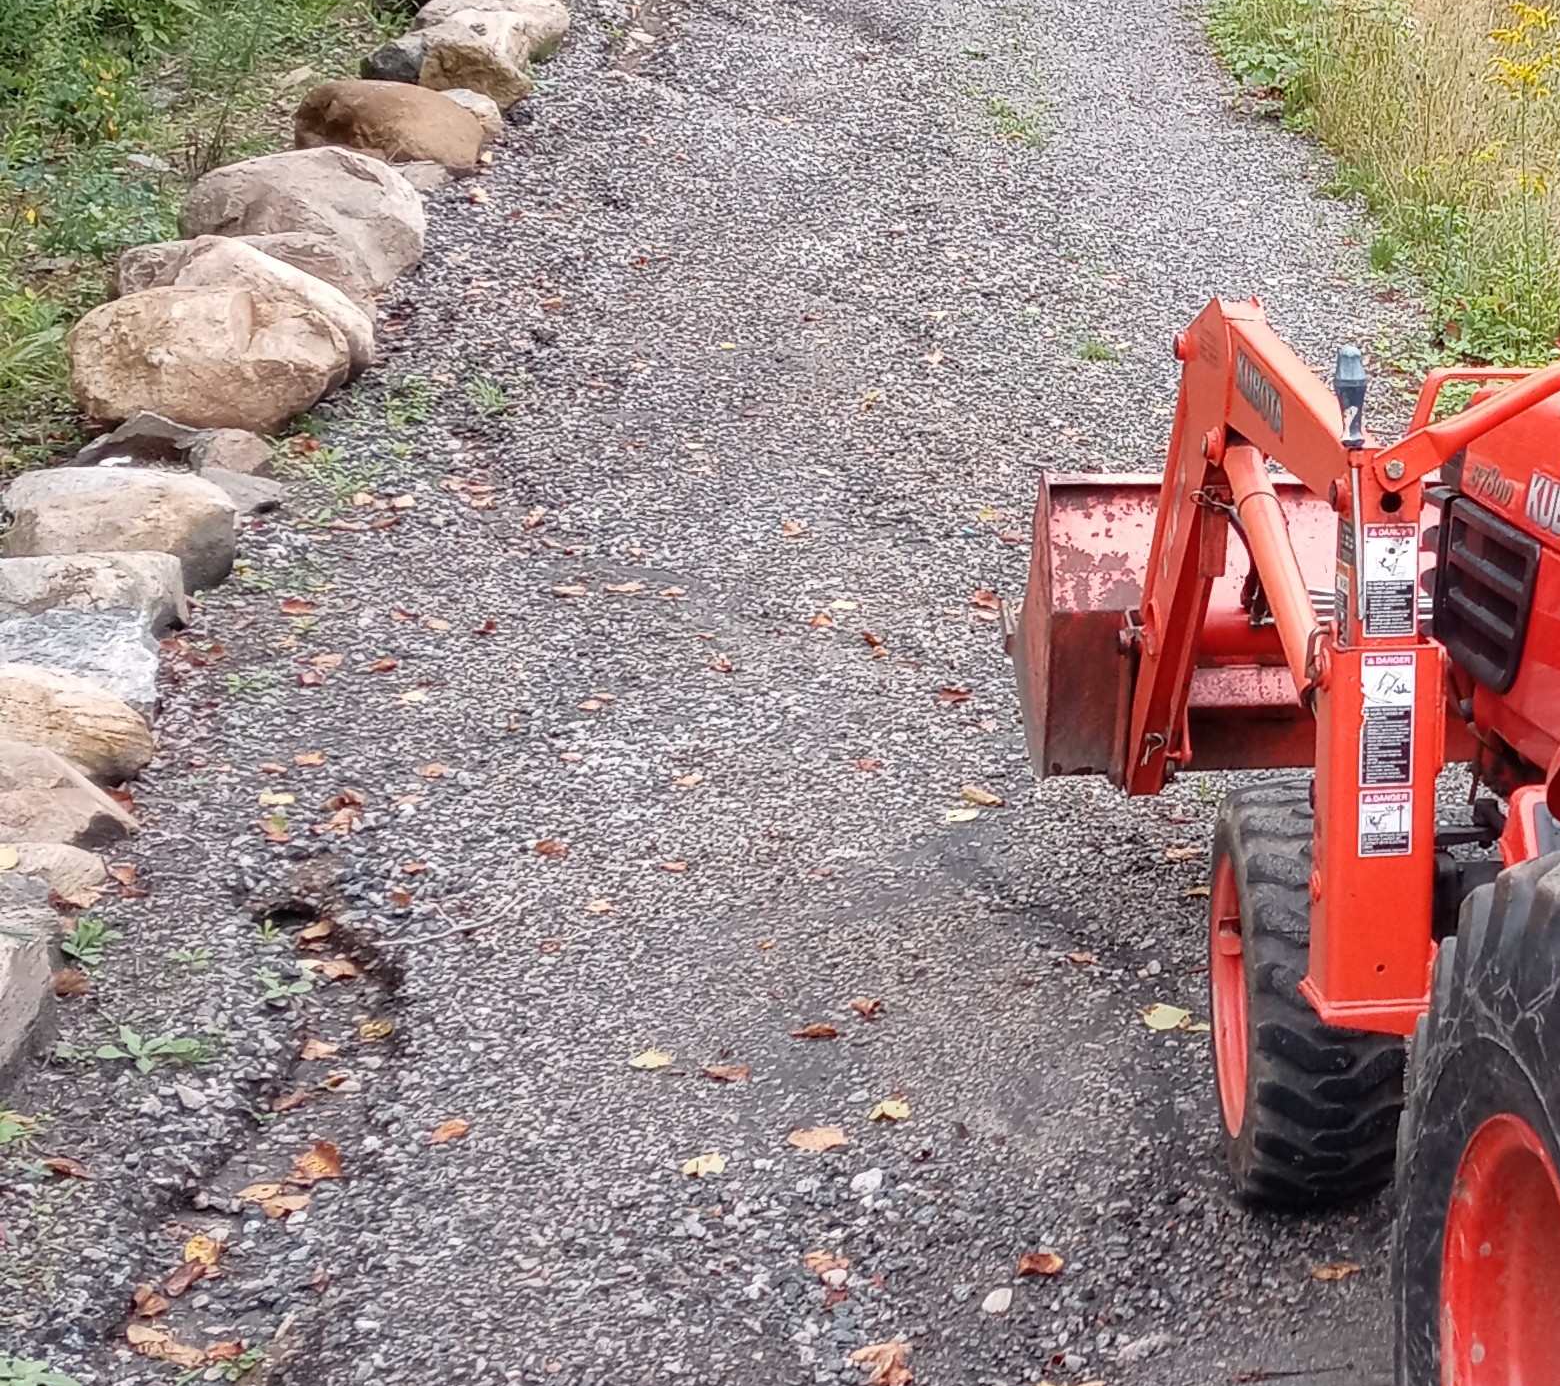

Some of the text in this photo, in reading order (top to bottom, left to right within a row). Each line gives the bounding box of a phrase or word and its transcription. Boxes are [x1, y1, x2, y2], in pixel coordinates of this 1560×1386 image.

[1236, 348, 1284, 439] KUBOTA
[1376, 656, 1411, 665] DANGER
[1372, 793, 1408, 803] DANGER
